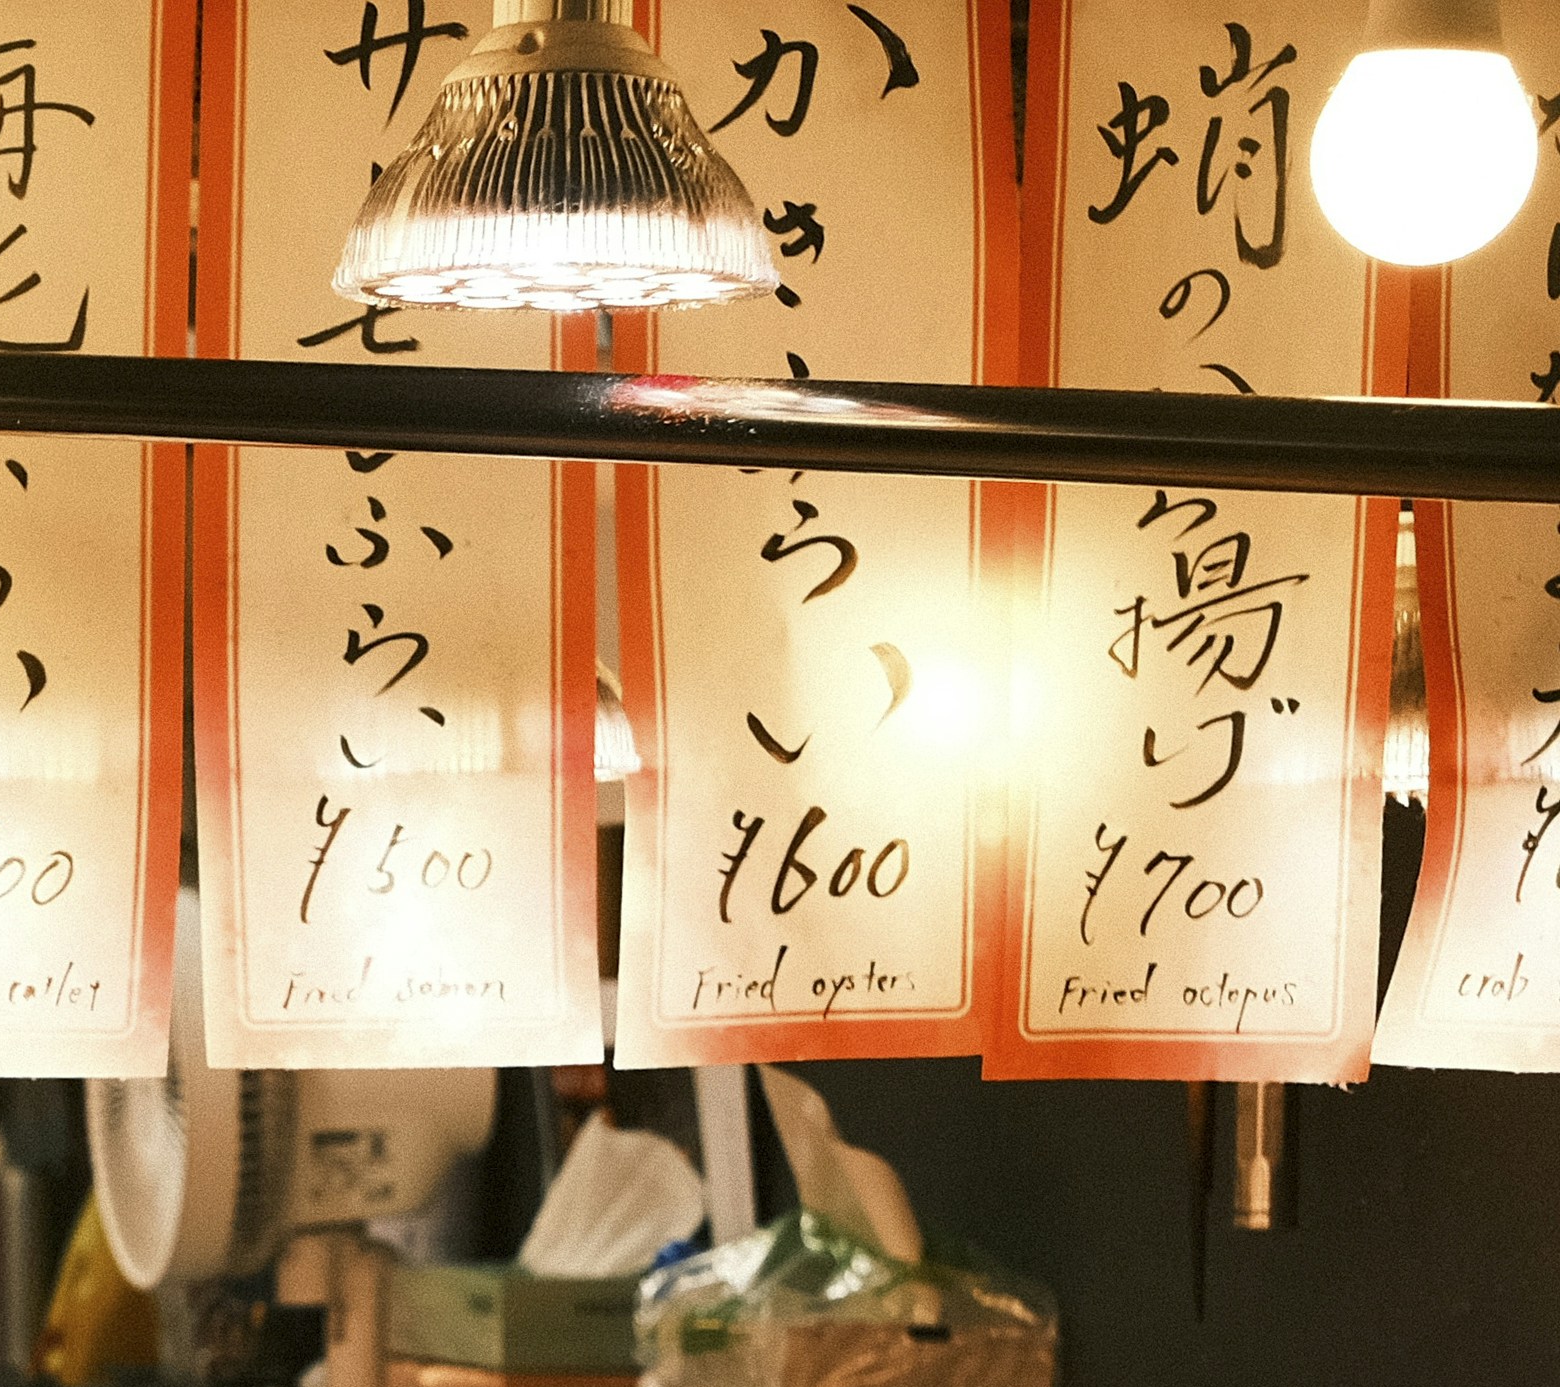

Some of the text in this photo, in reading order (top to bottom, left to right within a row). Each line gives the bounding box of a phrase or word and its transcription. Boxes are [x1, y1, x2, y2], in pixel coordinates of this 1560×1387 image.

[299, 795, 493, 925] ¥500
[718, 805, 911, 924] ¥600
[1081, 821, 1264, 946] ¥700
[695, 946, 788, 1012] Fried
[1058, 963, 1297, 1033] Fried octopus
